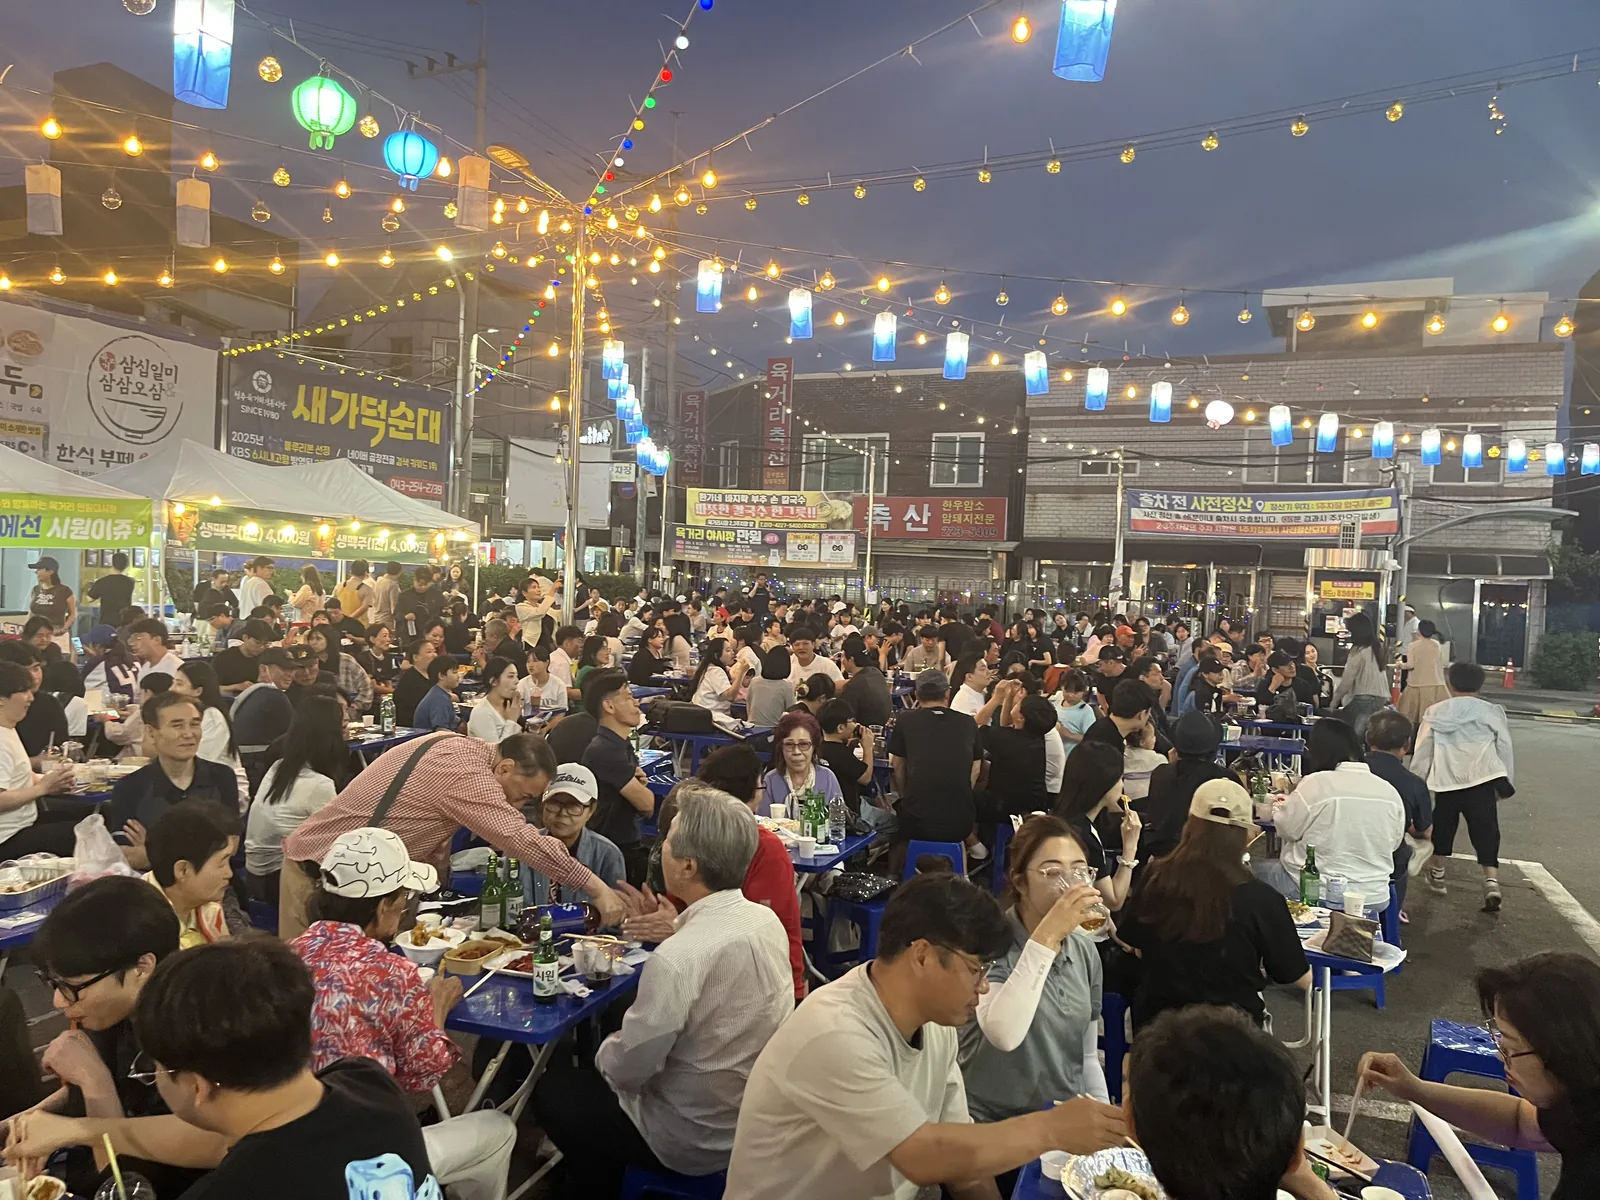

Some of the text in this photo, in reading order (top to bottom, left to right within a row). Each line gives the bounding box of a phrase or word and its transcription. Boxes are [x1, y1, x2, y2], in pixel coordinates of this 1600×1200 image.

[119, 355, 179, 384] 삼십일미
[292, 384, 441, 448] 새가덕순대
[767, 362, 789, 467] 육거리축산
[231, 431, 264, 446] 2025년
[57, 443, 134, 468] 한식 부페
[231, 446, 251, 458] KBS
[390, 478, 443, 495] 043-254-2739
[695, 503, 816, 519] 따뜻한 칼국수 한그릇!!
[942, 500, 984, 511] 한우암소
[1139, 493, 1253, 512] 출차 전 사전정산
[0, 514, 133, 541] 에선 시원이쥬
[942, 513, 995, 525] 암돼지전문
[265, 528, 310, 546] 4,000원
[676, 527, 704, 540] 육거리
[706, 530, 735, 542] 야시장
[737, 530, 762, 545] 만원
[942, 526, 998, 537] 223-5409
[390, 539, 428, 554] 4,000원
[536, 969, 554, 982] 시원
